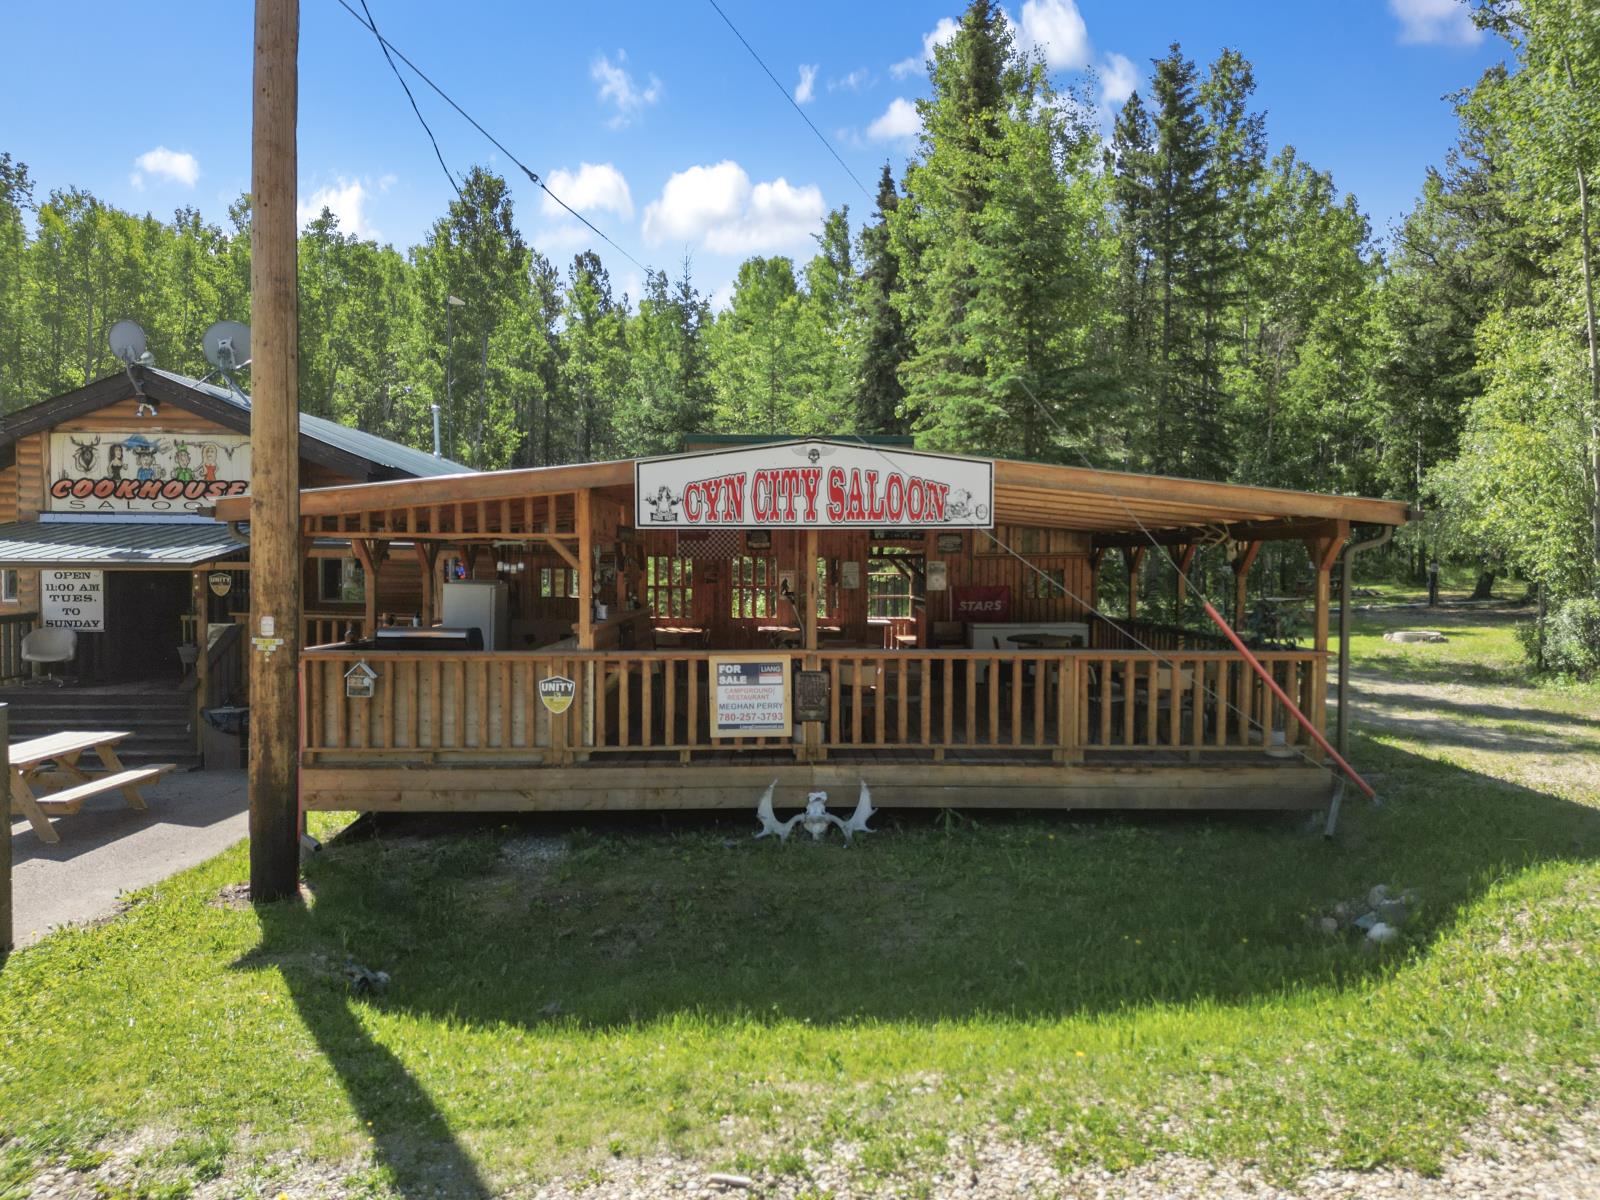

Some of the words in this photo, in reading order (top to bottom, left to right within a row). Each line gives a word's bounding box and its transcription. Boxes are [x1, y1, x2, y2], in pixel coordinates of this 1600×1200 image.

[51, 478, 248, 500] COOKHOUSE
[682, 472, 747, 522] CYN
[751, 467, 823, 522] CITY
[826, 466, 950, 523] SALOON
[54, 571, 91, 580] OPEN
[45, 583, 75, 591] 11:00
[79, 583, 100, 592] AM
[49, 594, 97, 602] TUES.
[958, 601, 1002, 611] STARS
[62, 607, 81, 616] TO
[45, 619, 100, 628] SUNDAY
[719, 664, 742, 673] FOR
[718, 675, 747, 685] SALE
[541, 682, 573, 692] UNITY
[719, 712, 783, 721] 780-257-3793
